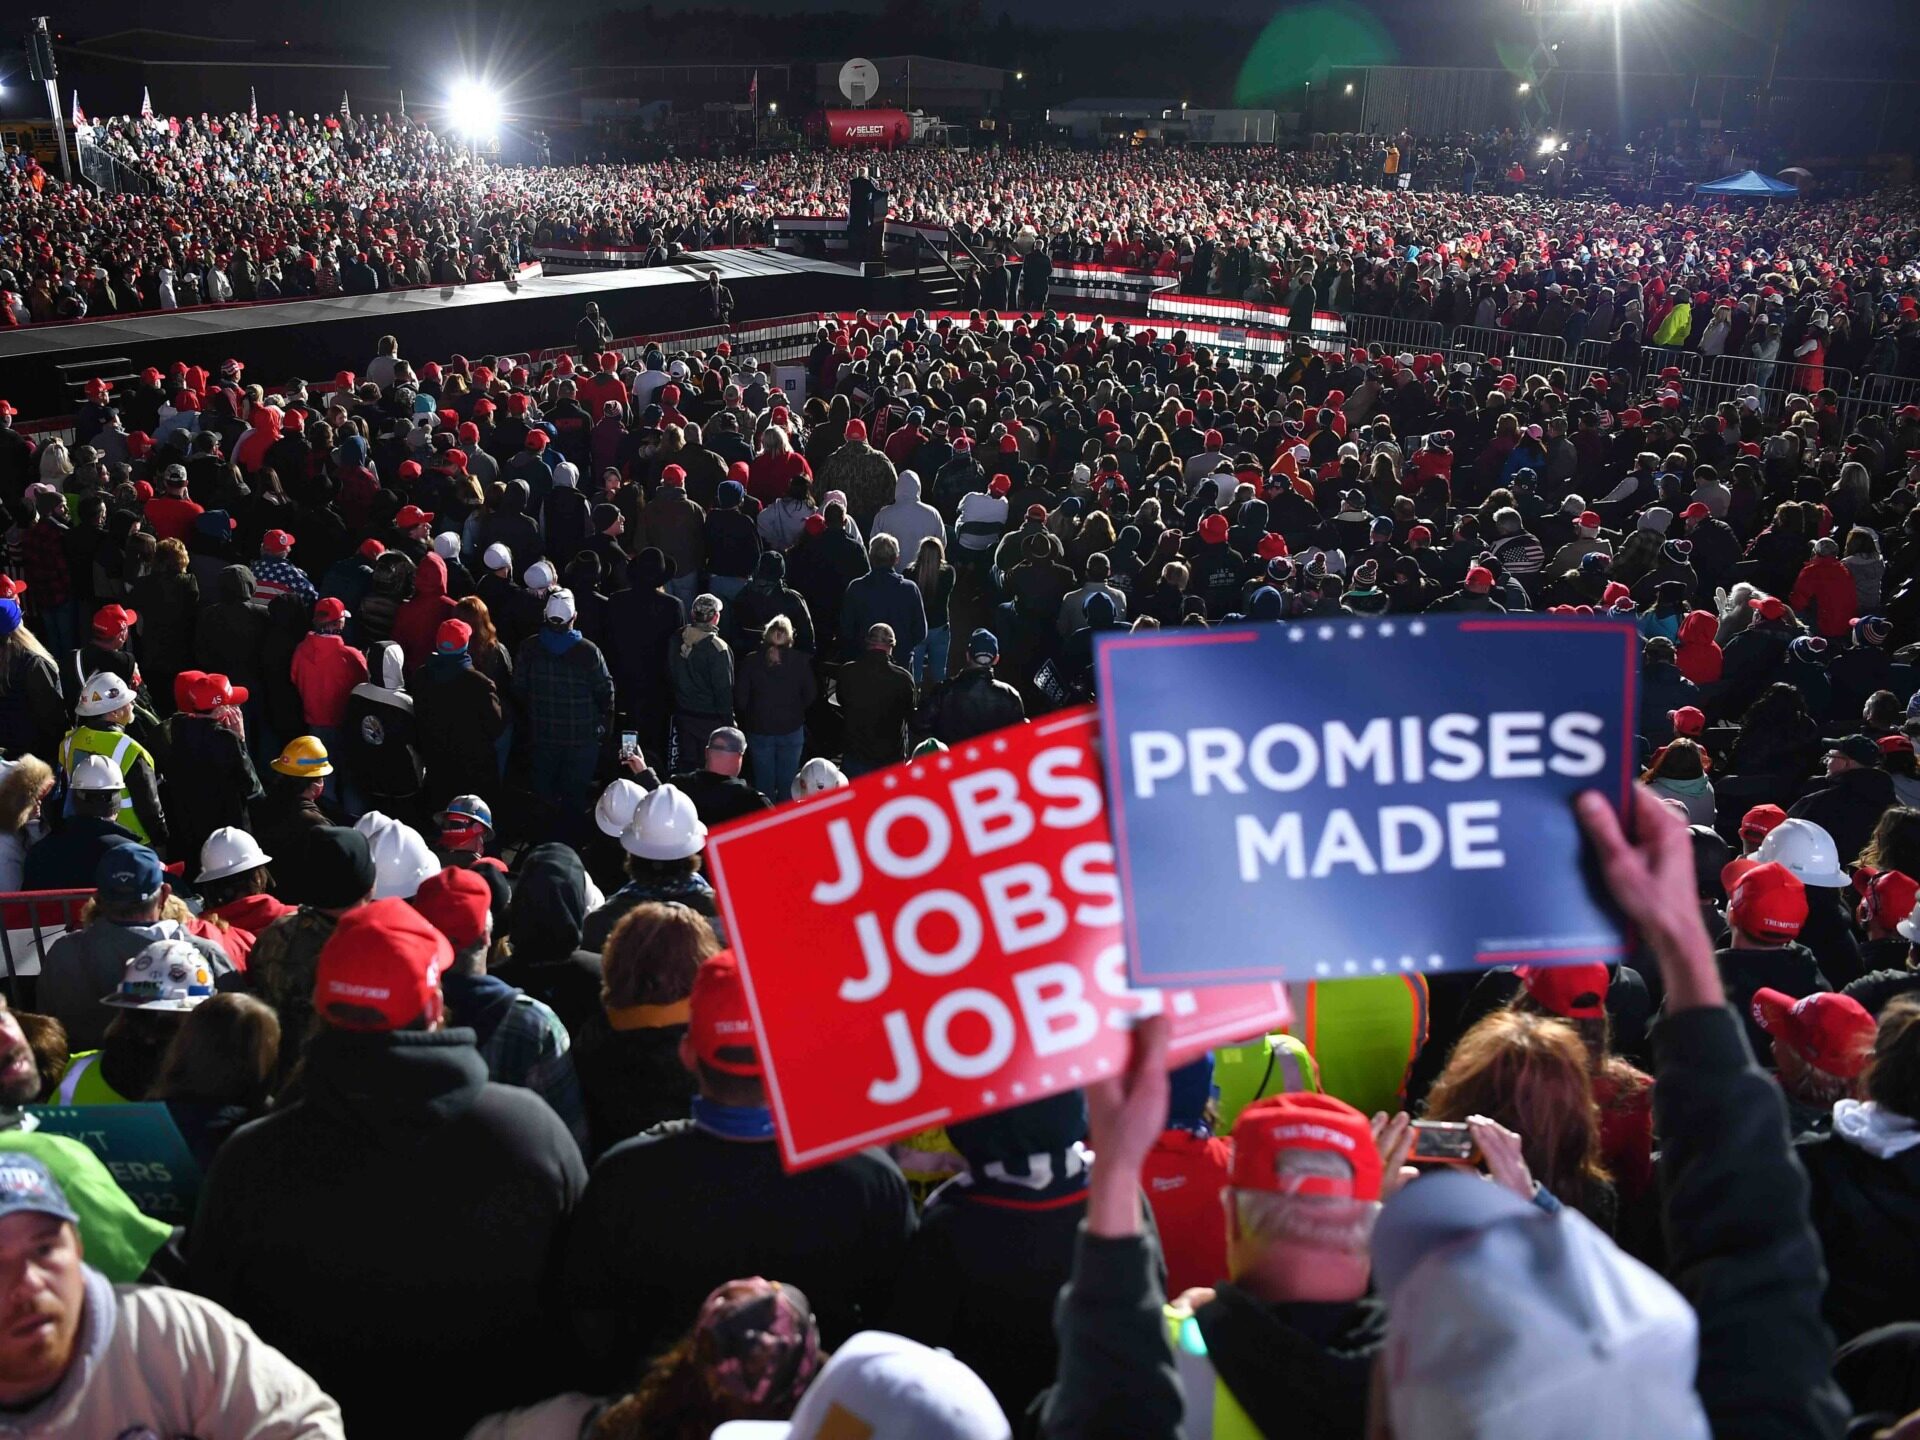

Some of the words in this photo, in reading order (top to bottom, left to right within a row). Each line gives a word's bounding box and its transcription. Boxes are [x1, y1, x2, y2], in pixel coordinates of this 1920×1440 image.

[856, 125, 884, 135] SELECT
[1129, 711, 1607, 798] PROMISES
[1236, 800, 1506, 883] MADE
